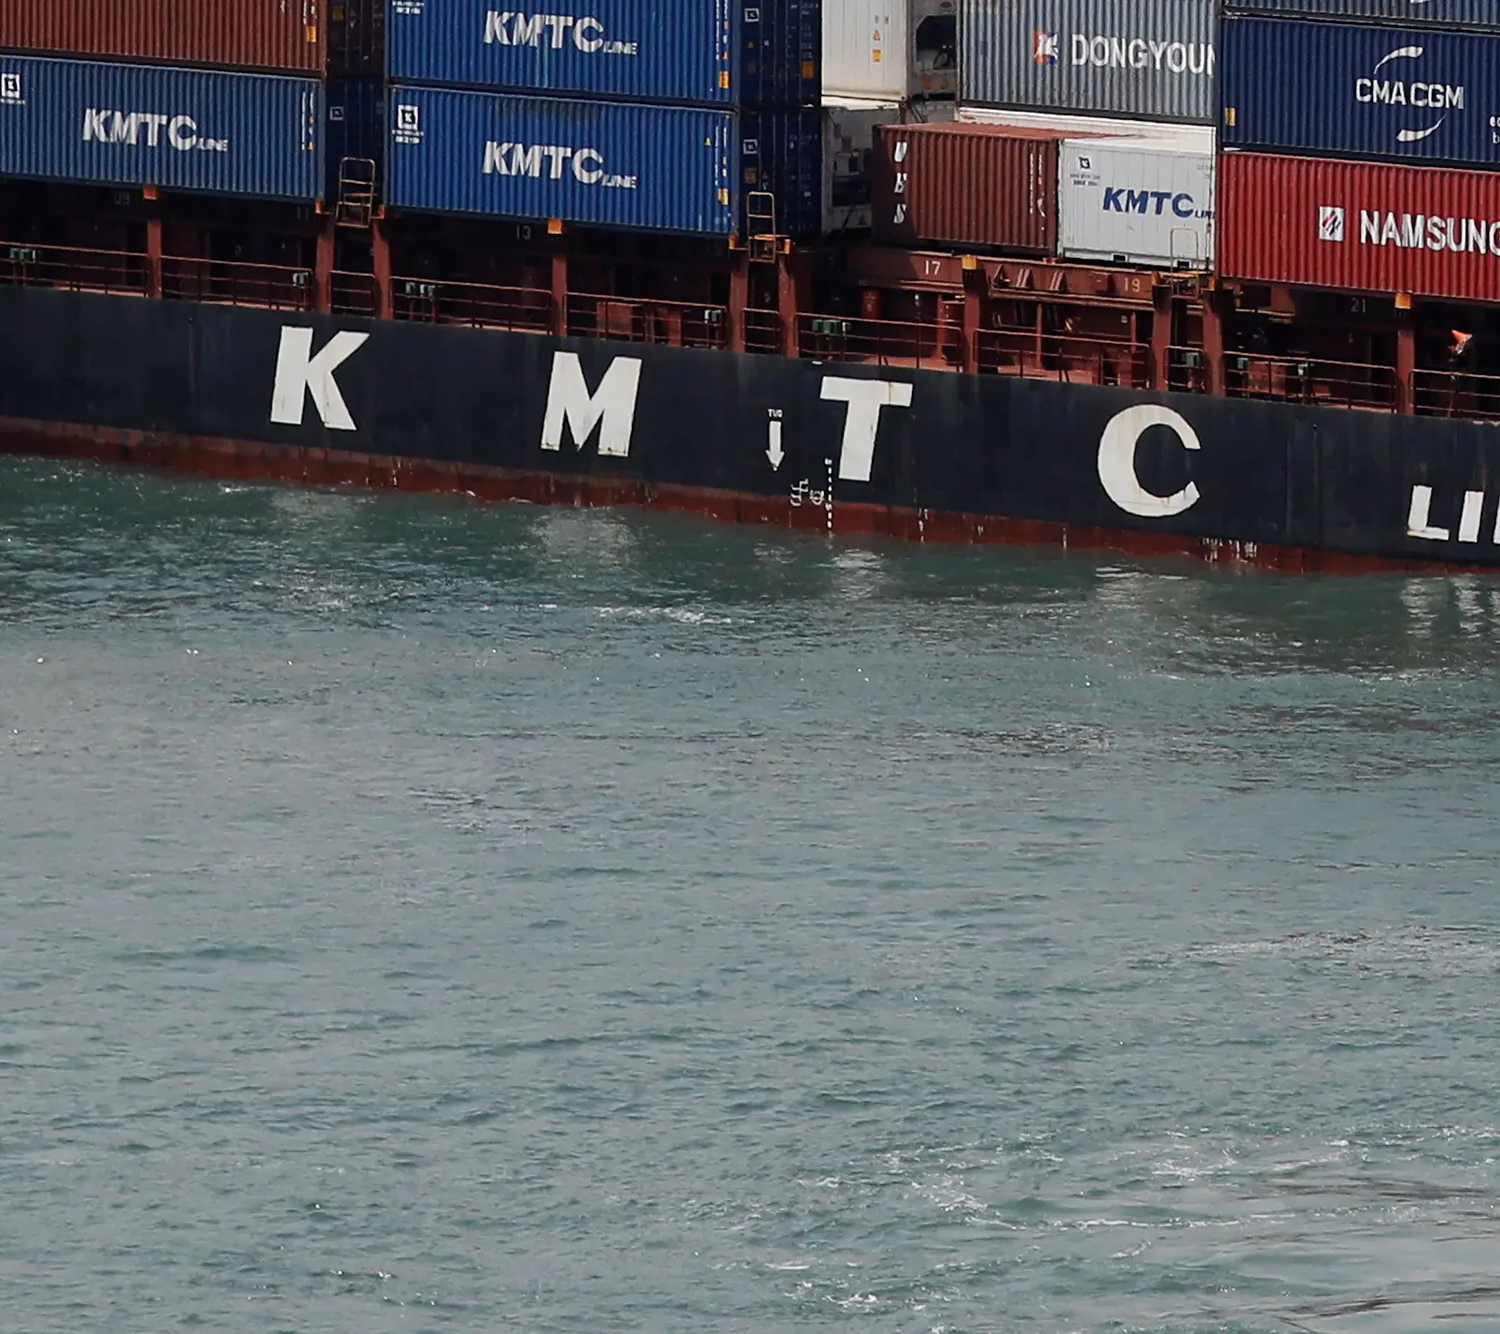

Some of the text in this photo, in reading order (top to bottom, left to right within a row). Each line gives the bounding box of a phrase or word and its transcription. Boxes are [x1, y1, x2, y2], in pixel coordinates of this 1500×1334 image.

[483, 10, 638, 56] KMTC LINE
[1355, 77, 1464, 110] CMA CGM
[82, 108, 229, 152] KMTC LINE
[482, 140, 638, 190] KMTC LINE
[1102, 186, 1194, 218] KMTC
[924, 260, 941, 275] 17
[1124, 278, 1141, 293] 19
[1351, 298, 1367, 313] 21
